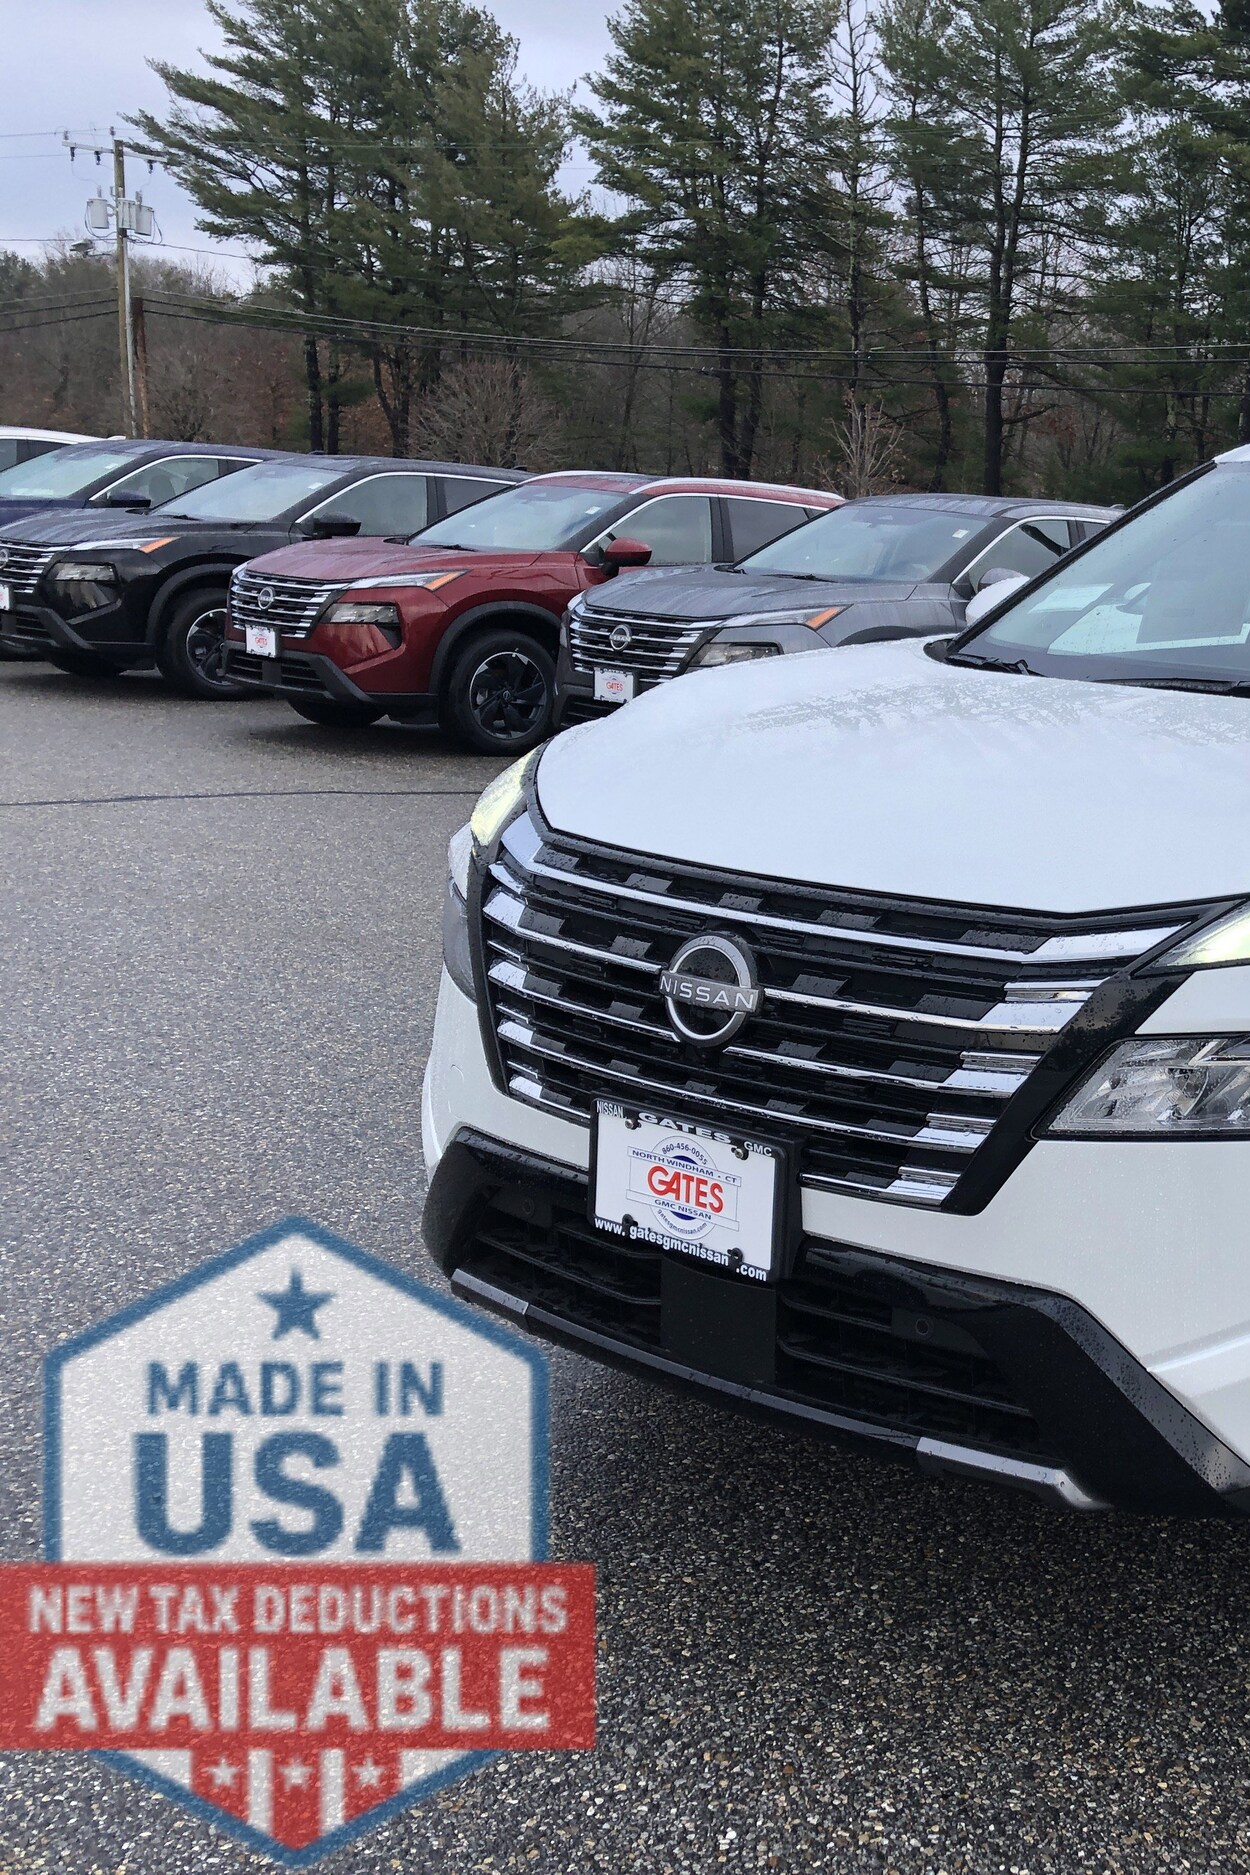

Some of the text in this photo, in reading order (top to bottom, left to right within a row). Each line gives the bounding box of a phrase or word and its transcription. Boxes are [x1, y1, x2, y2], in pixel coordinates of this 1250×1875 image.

[660, 976, 753, 1008] NISSAN
[596, 1100, 624, 1119] NISSAN
[638, 1112, 731, 1144] GATES
[662, 1143, 708, 1165] 860-456-0055
[743, 1141, 772, 1157] GMC
[632, 1150, 737, 1184] NORTH WINDHAM CT
[647, 1165, 724, 1213] GATES
[654, 1199, 712, 1220] GMC NISSAN
[657, 1209, 708, 1235] gatesgmcnissan.com
